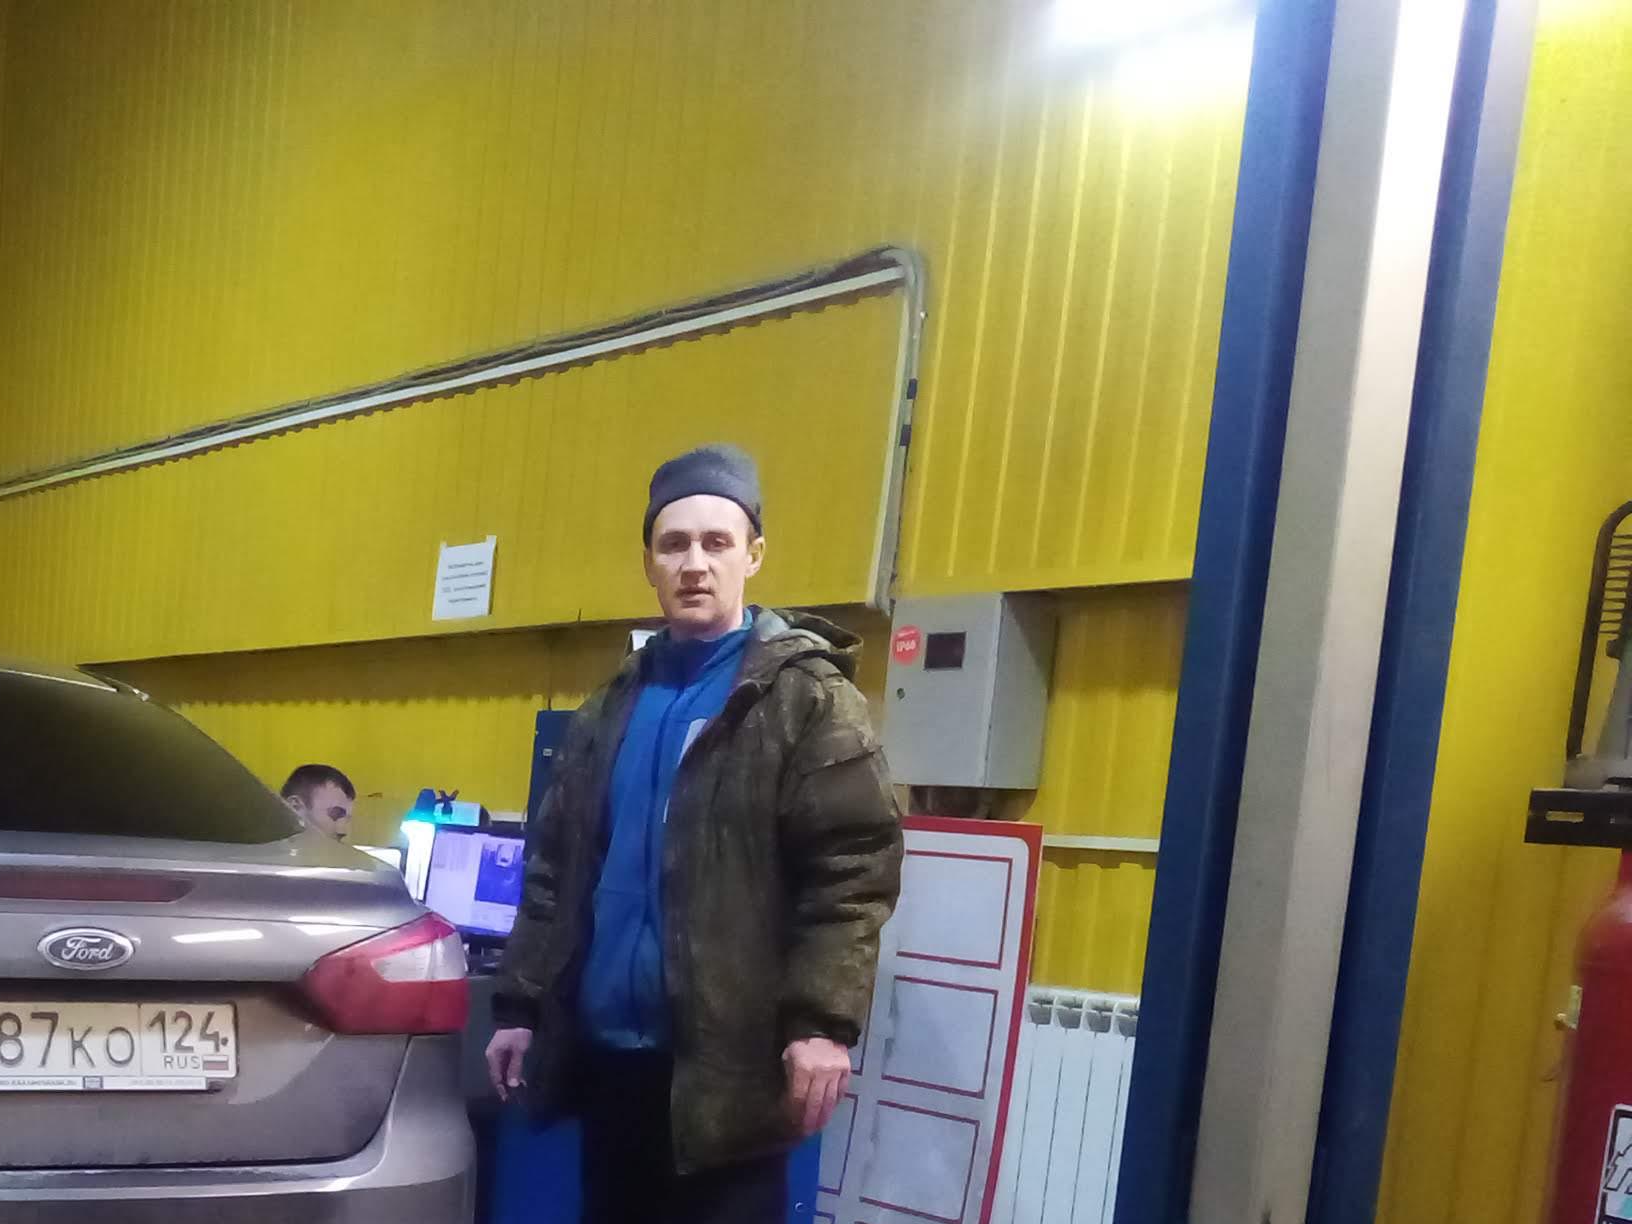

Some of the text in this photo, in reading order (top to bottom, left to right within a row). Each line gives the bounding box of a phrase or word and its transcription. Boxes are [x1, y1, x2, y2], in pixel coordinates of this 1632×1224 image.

[61, 937, 114, 960] Ford
[148, 1010, 220, 1053] 124
[163, 1055, 200, 1069] RUS
